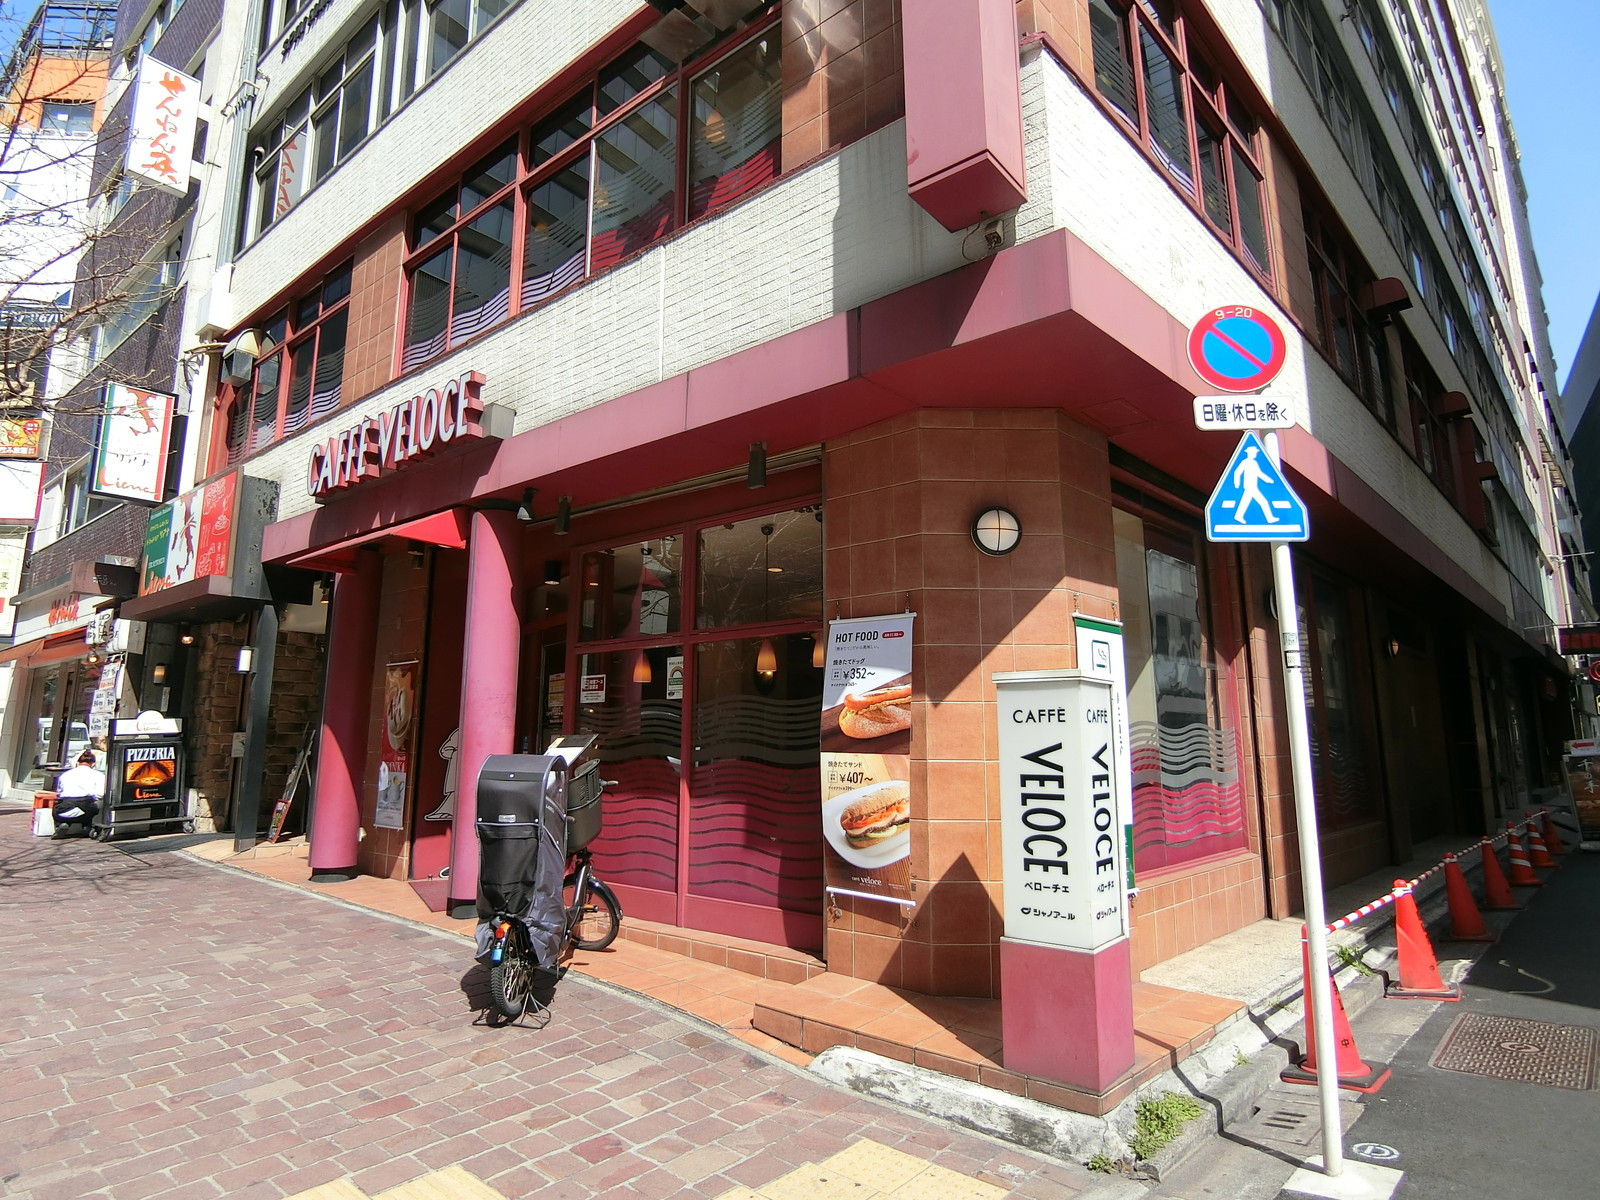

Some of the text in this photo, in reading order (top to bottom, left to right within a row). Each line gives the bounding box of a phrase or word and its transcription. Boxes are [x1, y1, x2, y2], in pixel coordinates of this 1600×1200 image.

[1215, 307, 1252, 319] 9-20
[378, 370, 486, 470] VELOCE
[1202, 402, 1288, 422] 日曜・休日を除く
[835, 630, 879, 643] HOT FOOD
[1012, 706, 1066, 724] CAFFÈ
[127, 747, 176, 762] PIZZERIA
[1020, 742, 1069, 876] VELOCE
[1091, 742, 1114, 876] VELOCE
[1024, 882, 1070, 893] ベローチェ
[1033, 908, 1076, 921] シャノアール
